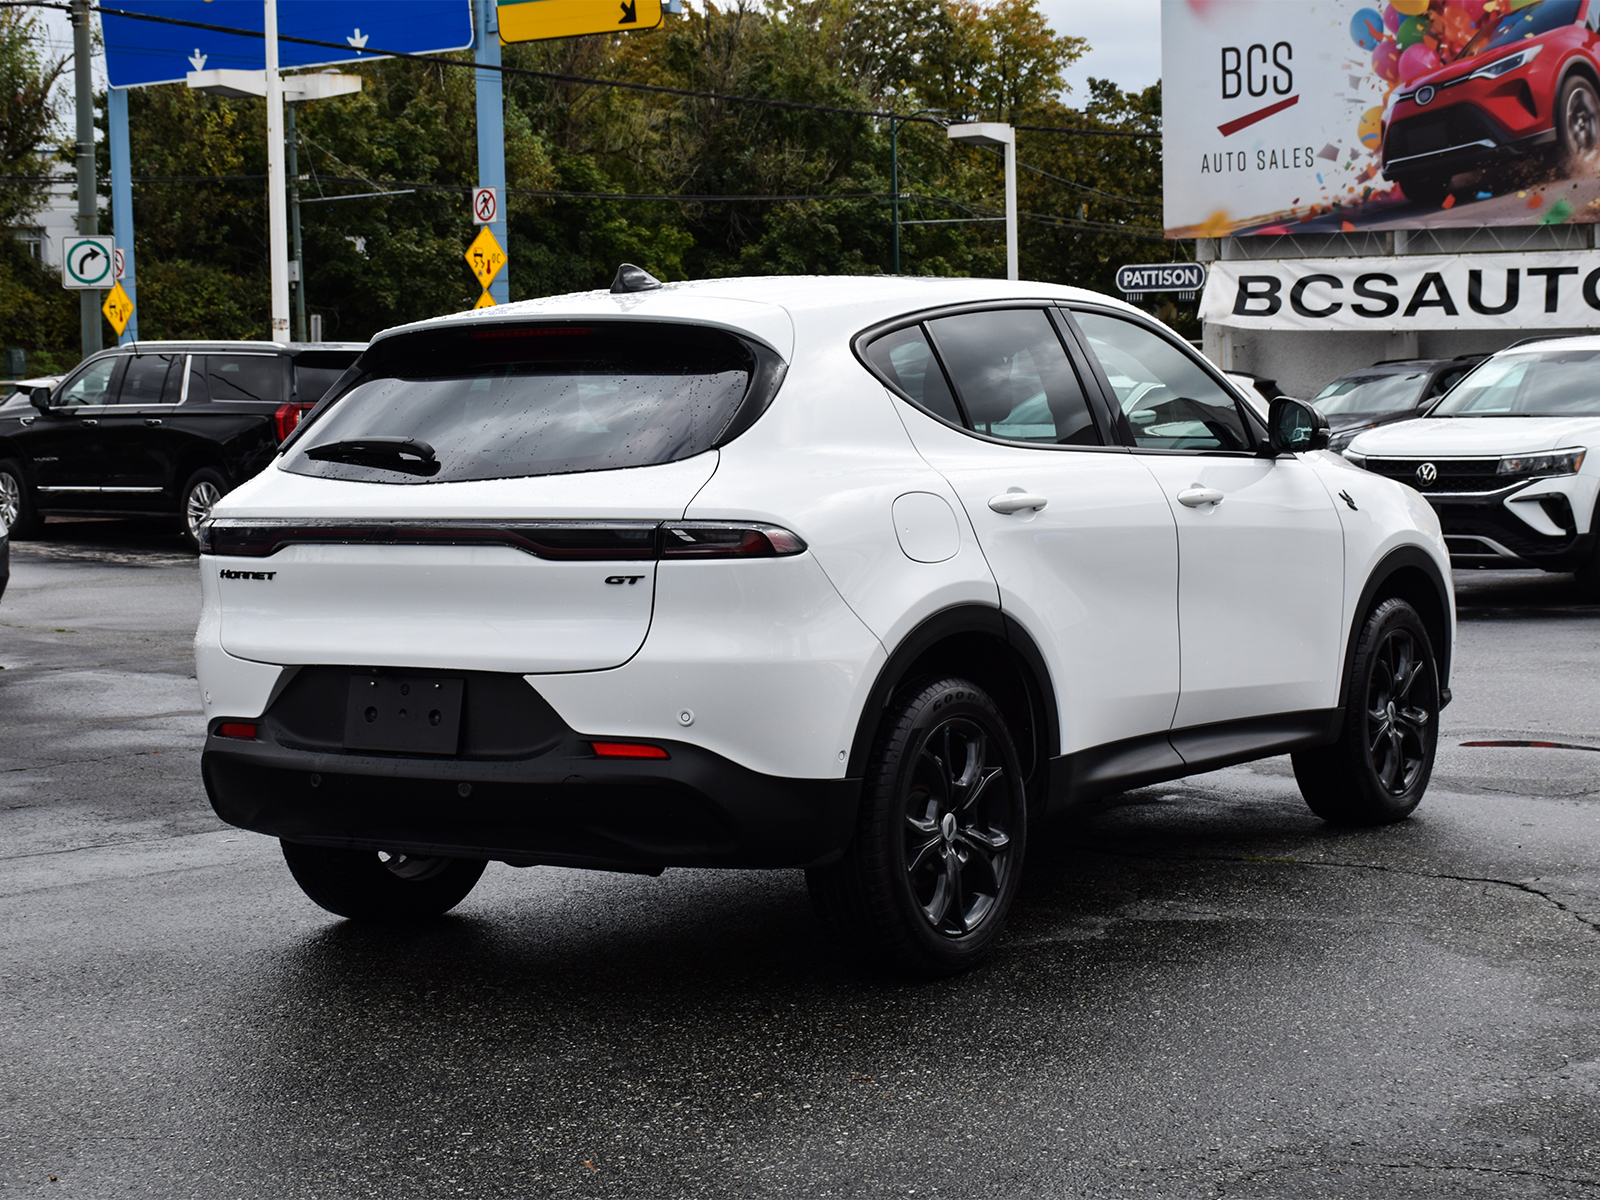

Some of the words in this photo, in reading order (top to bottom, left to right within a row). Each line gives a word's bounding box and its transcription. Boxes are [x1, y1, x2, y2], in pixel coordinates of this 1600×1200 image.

[1221, 40, 1293, 100] BCS
[1201, 151, 1247, 174] AUTO
[1257, 146, 1314, 171] SALES
[1123, 269, 1198, 287] PATTISON
[604, 575, 646, 585] GT
